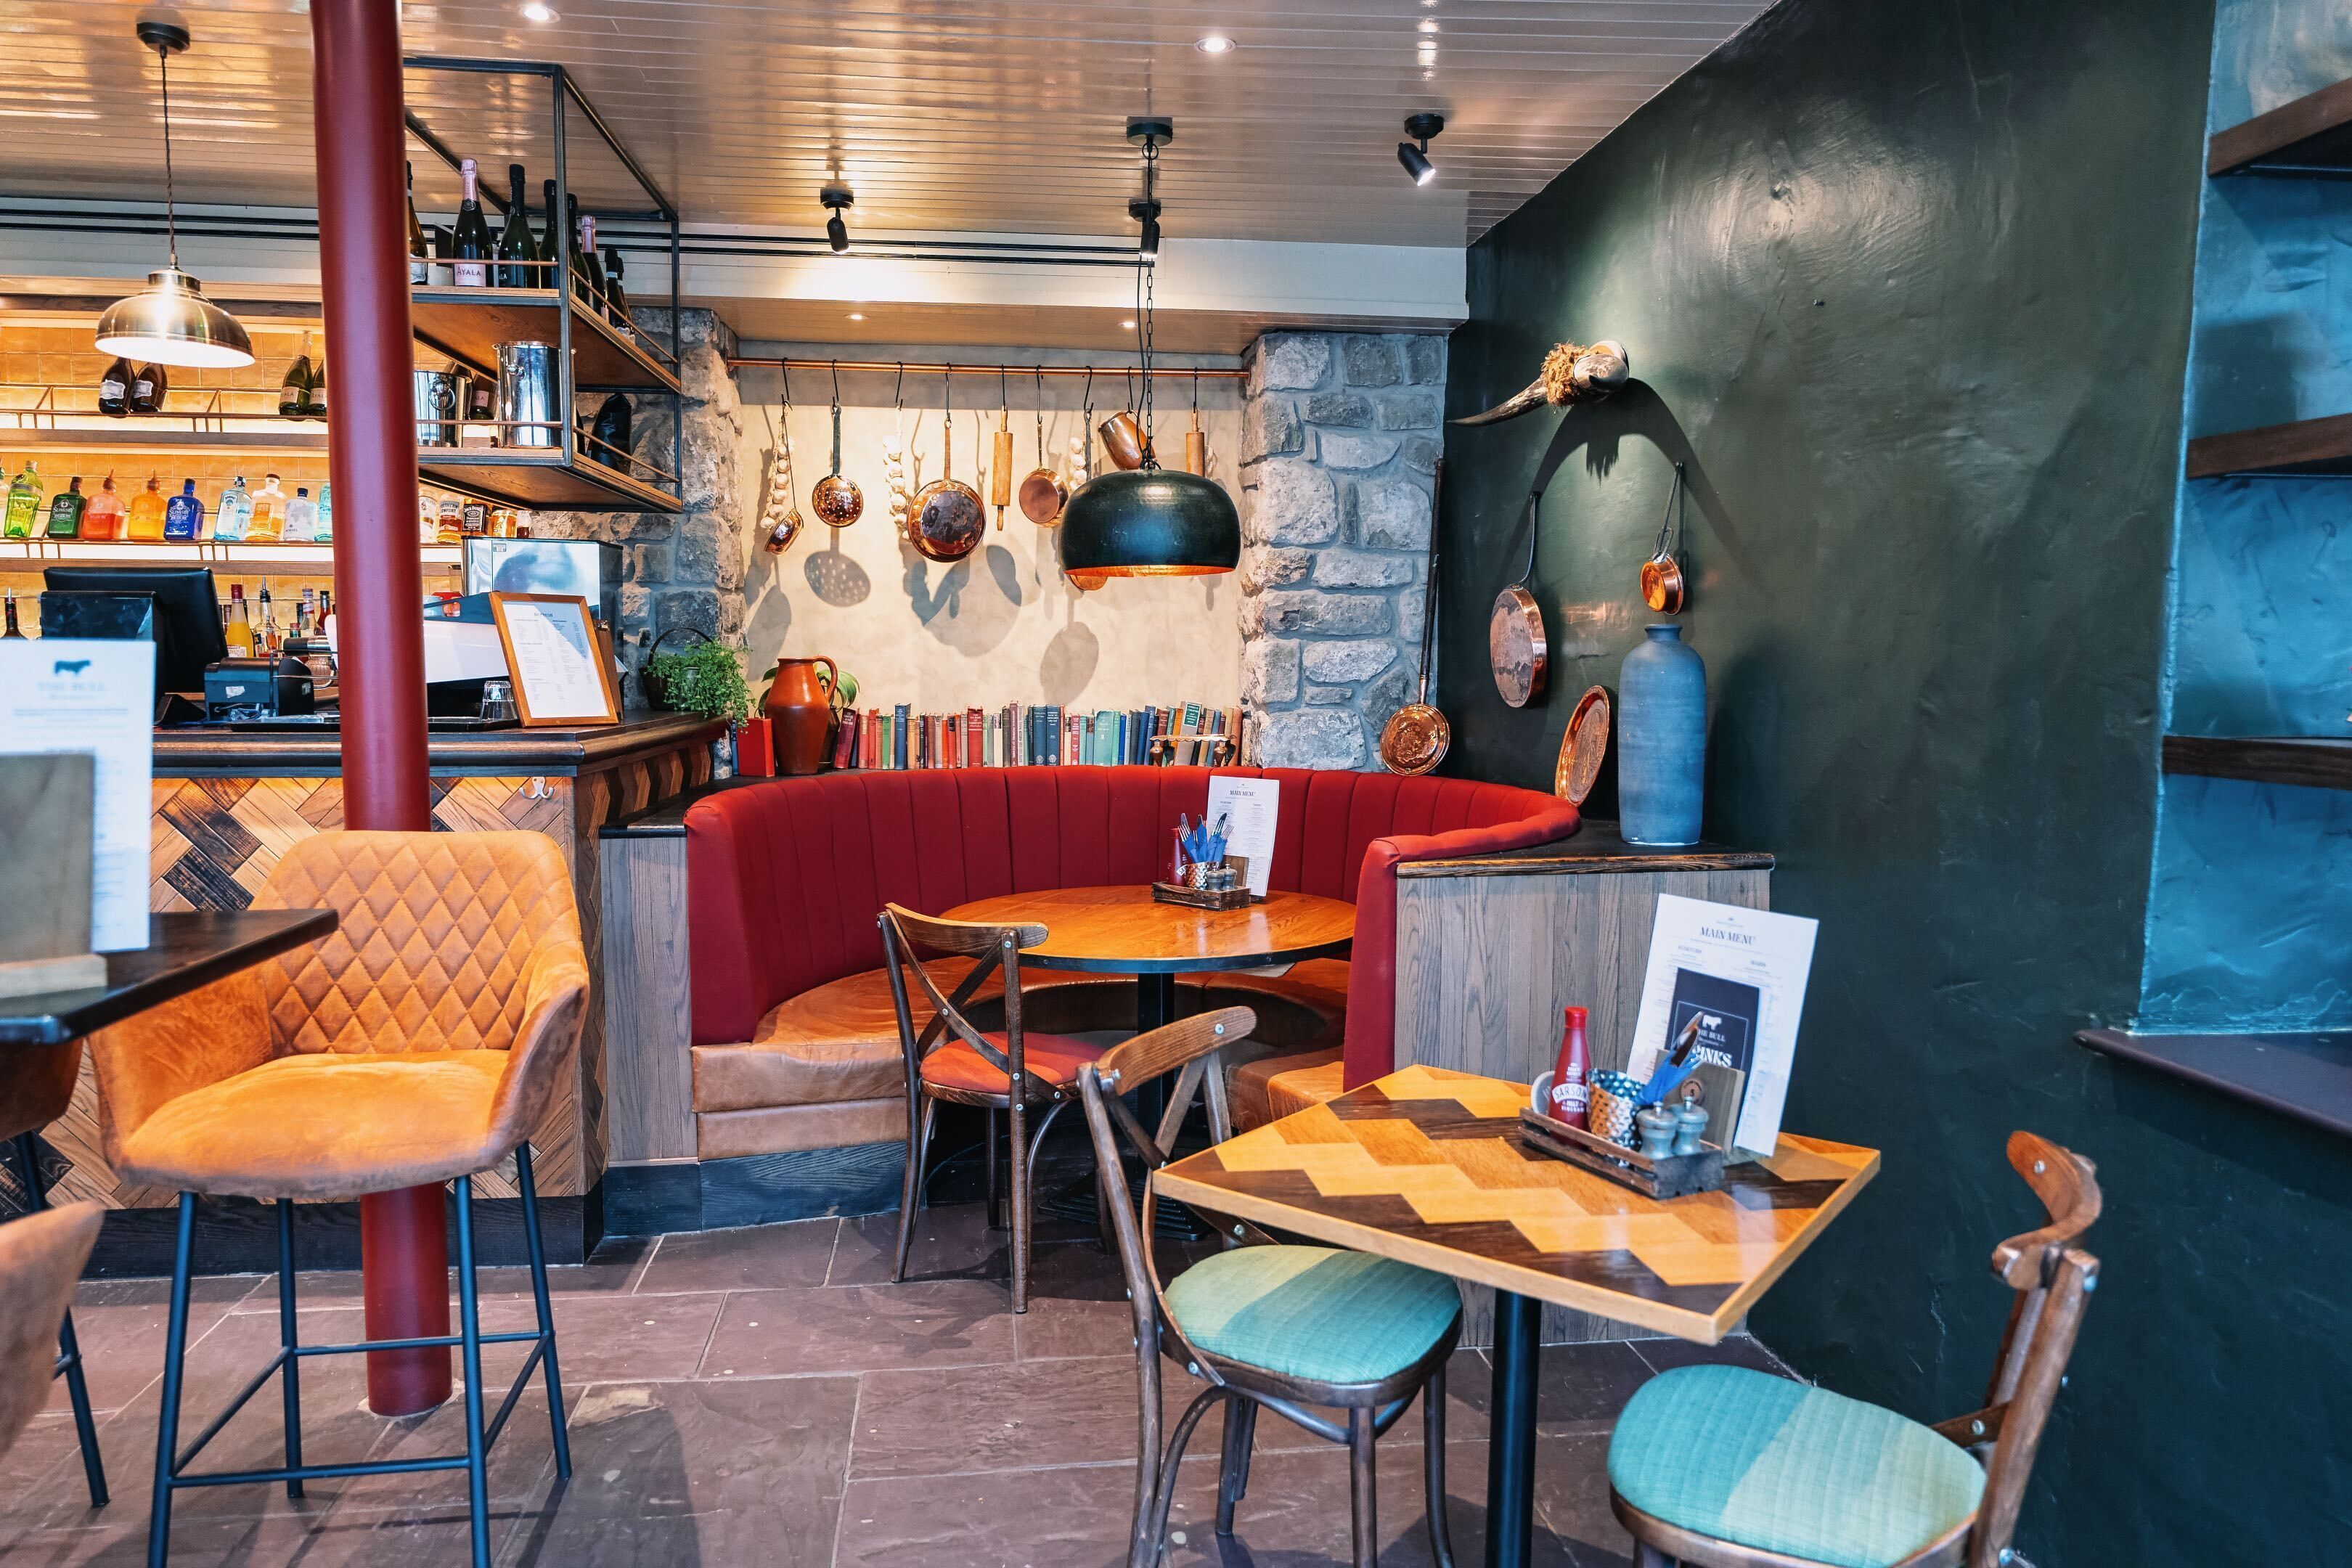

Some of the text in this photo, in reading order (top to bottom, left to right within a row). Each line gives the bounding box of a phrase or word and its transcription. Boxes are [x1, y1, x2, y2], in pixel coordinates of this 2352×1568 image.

[457, 266, 482, 277] AYALA
[1699, 926, 1756, 945] MAIN MENU
[1709, 1032, 1726, 1042] BULL
[1554, 1085, 1587, 1099] SARSON
